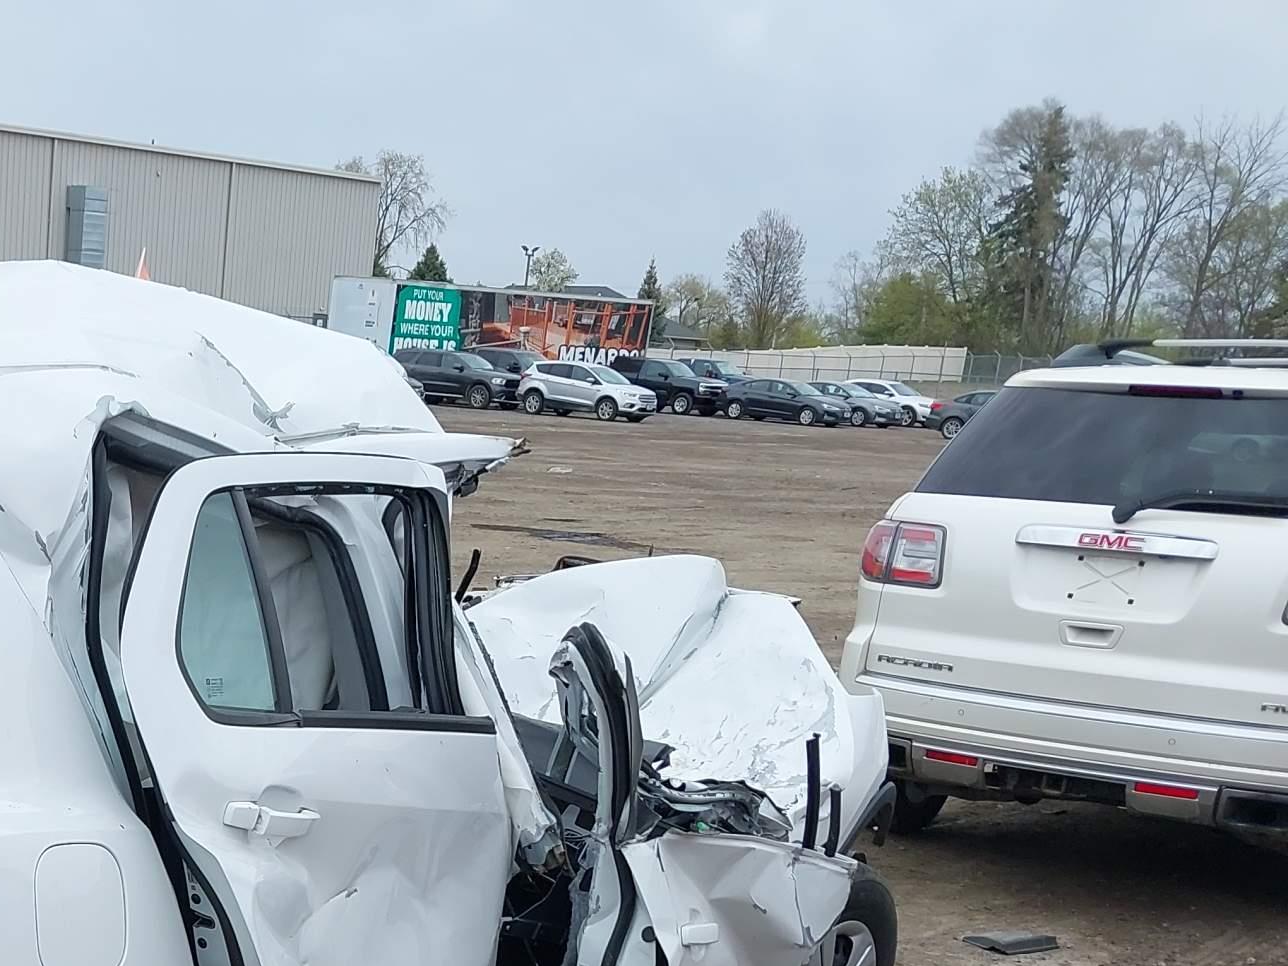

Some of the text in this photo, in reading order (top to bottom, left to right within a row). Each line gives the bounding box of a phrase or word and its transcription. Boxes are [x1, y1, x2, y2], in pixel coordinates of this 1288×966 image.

[413, 289, 444, 301] PUT YOUR
[404, 300, 452, 322] MONEY
[400, 323, 454, 337] WHERE YOUR
[1079, 533, 1146, 551] GMC
[877, 654, 954, 672] ACADIA
